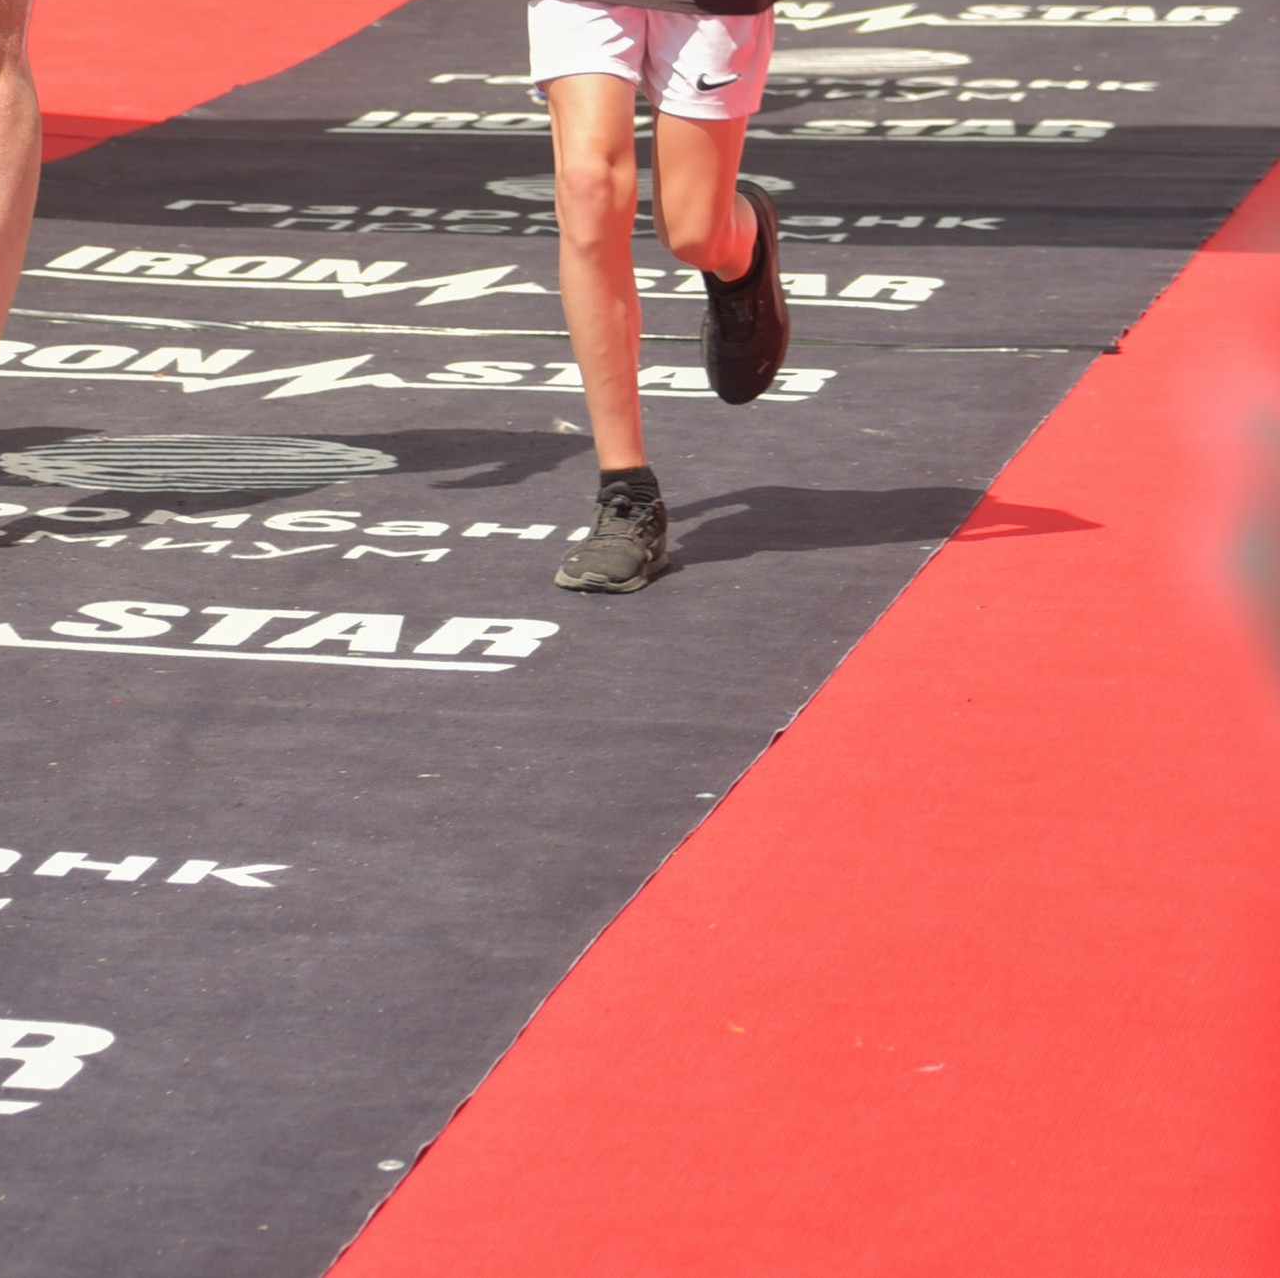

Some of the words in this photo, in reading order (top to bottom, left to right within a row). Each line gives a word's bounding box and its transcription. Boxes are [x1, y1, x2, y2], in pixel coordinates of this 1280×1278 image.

[792, 118, 1116, 138] STAR
[45, 245, 409, 284] IRON
[50, 600, 560, 657] STAR
